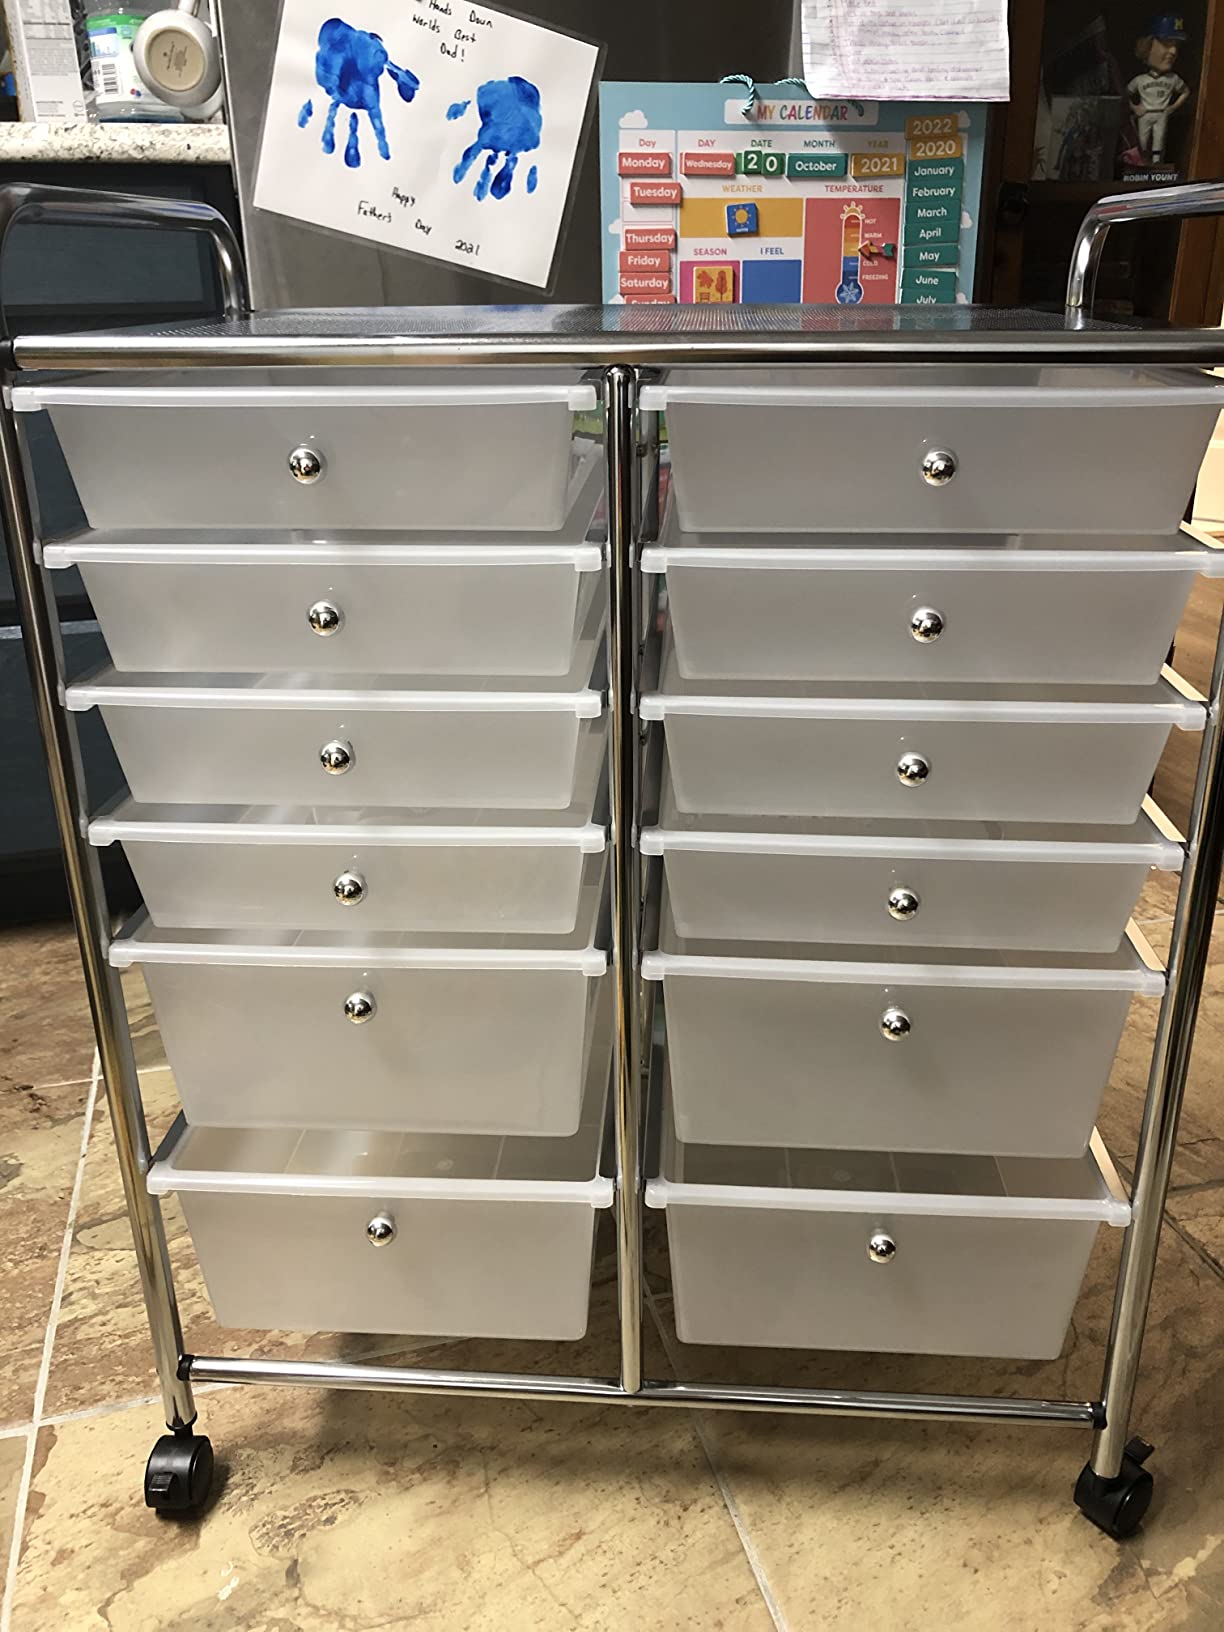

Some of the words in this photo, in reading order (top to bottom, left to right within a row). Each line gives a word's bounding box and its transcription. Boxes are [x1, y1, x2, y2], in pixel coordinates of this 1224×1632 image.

[469, 10, 493, 28] Down
[454, 29, 477, 43] Best
[757, 105, 776, 120] MY
[780, 104, 848, 121] CALENDAR
[912, 118, 953, 135] 2022
[639, 138, 656, 148] Day
[698, 139, 716, 148] DAY
[751, 139, 773, 148] DATE
[803, 139, 835, 148] MONTH
[867, 140, 889, 149] YEAR
[915, 140, 957, 157] 2020
[622, 157, 665, 169] Monday
[686, 158, 733, 170] Wednesday
[795, 160, 837, 172] October
[860, 156, 898, 173] 2021
[913, 164, 955, 177] January
[1123, 174, 1149, 182] ROBIN
[1151, 173, 1178, 181] YOUNT
[633, 187, 678, 199] Tuesday
[722, 184, 763, 193] WEATHER
[825, 184, 884, 193] TEMPERATURE
[912, 187, 956, 199] February
[392, 186, 416, 208] Happy
[917, 207, 948, 218] March
[625, 233, 674, 246] Thursday
[919, 228, 942, 240] April
[693, 248, 728, 256] SEASON
[764, 247, 785, 255] FEEL
[919, 251, 940, 262] May
[627, 255, 661, 269] Friday
[620, 277, 669, 290] Saturday
[915, 274, 940, 286] June
